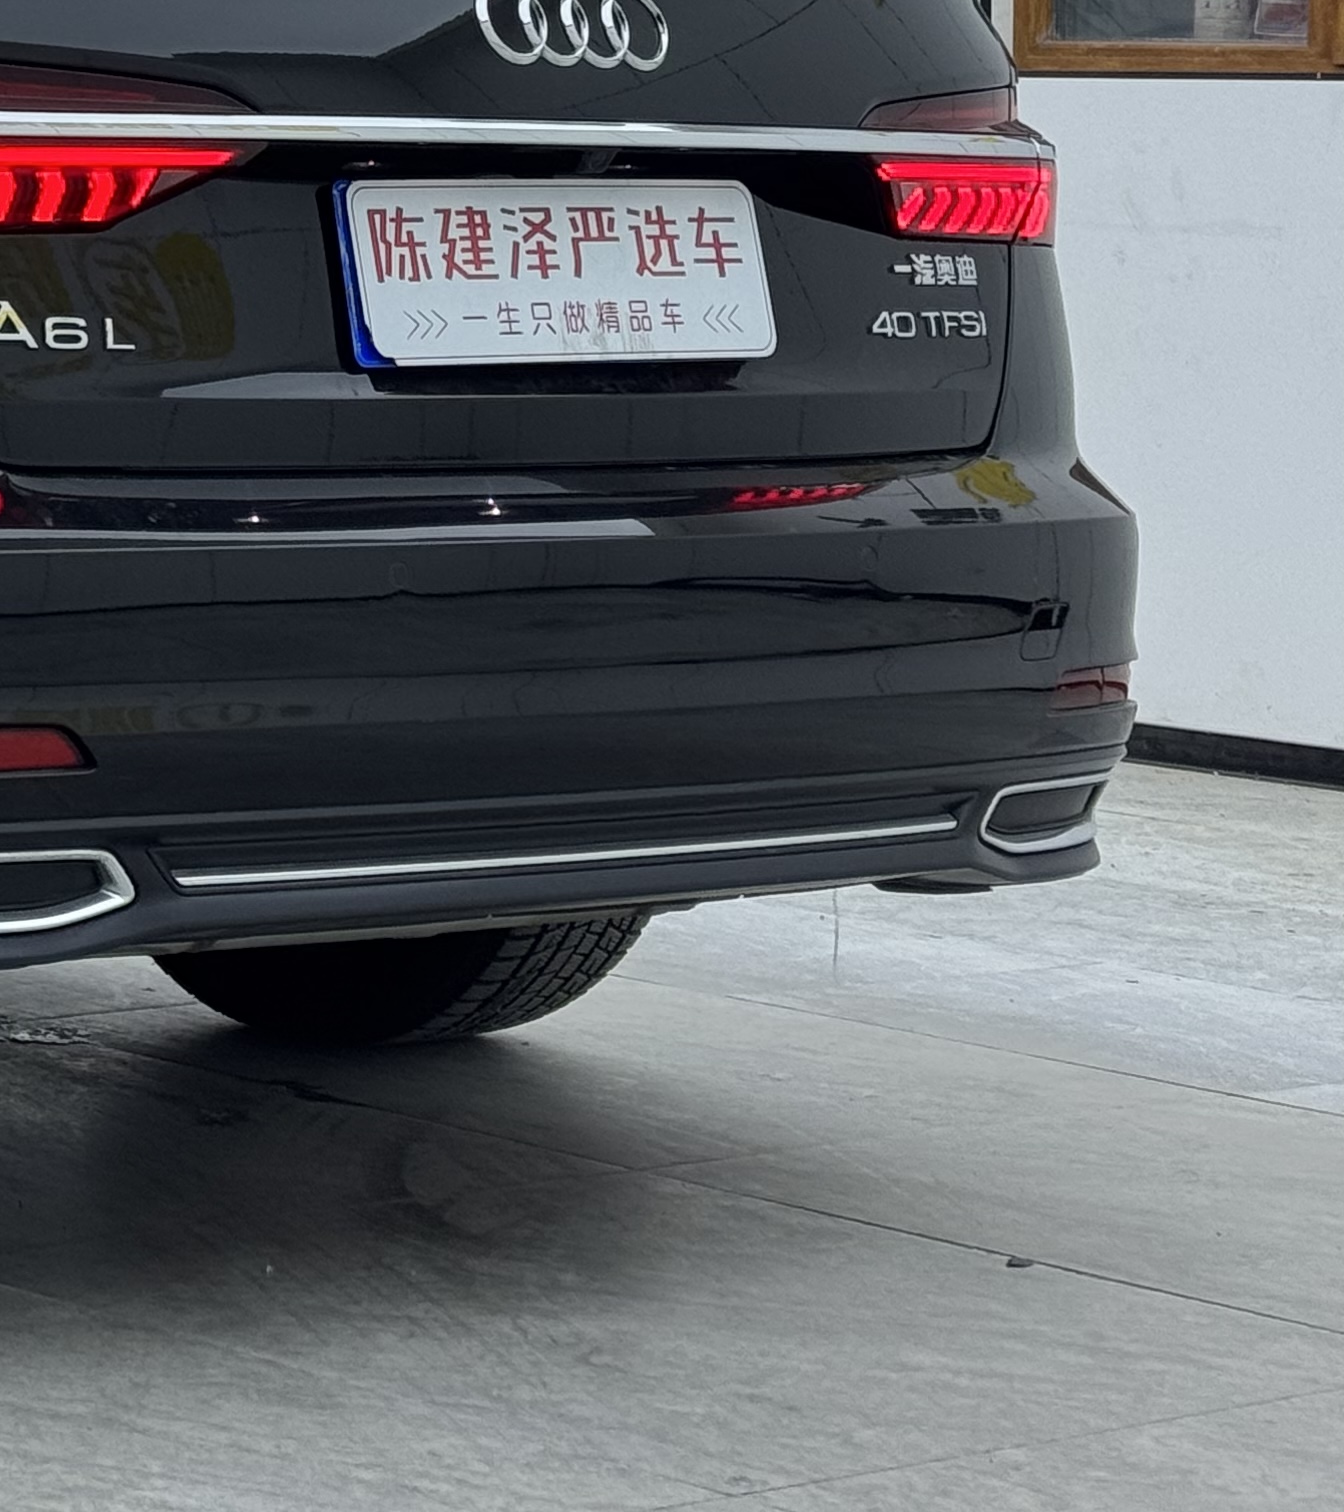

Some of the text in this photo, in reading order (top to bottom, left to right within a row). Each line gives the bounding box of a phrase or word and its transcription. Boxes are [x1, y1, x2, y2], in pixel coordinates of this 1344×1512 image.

[367, 205, 744, 284] 陈建泽严选车
[893, 254, 978, 286] 一汽奥迪
[462, 298, 686, 337] 一生只做精品车
[871, 310, 988, 338] 40 TFSI
